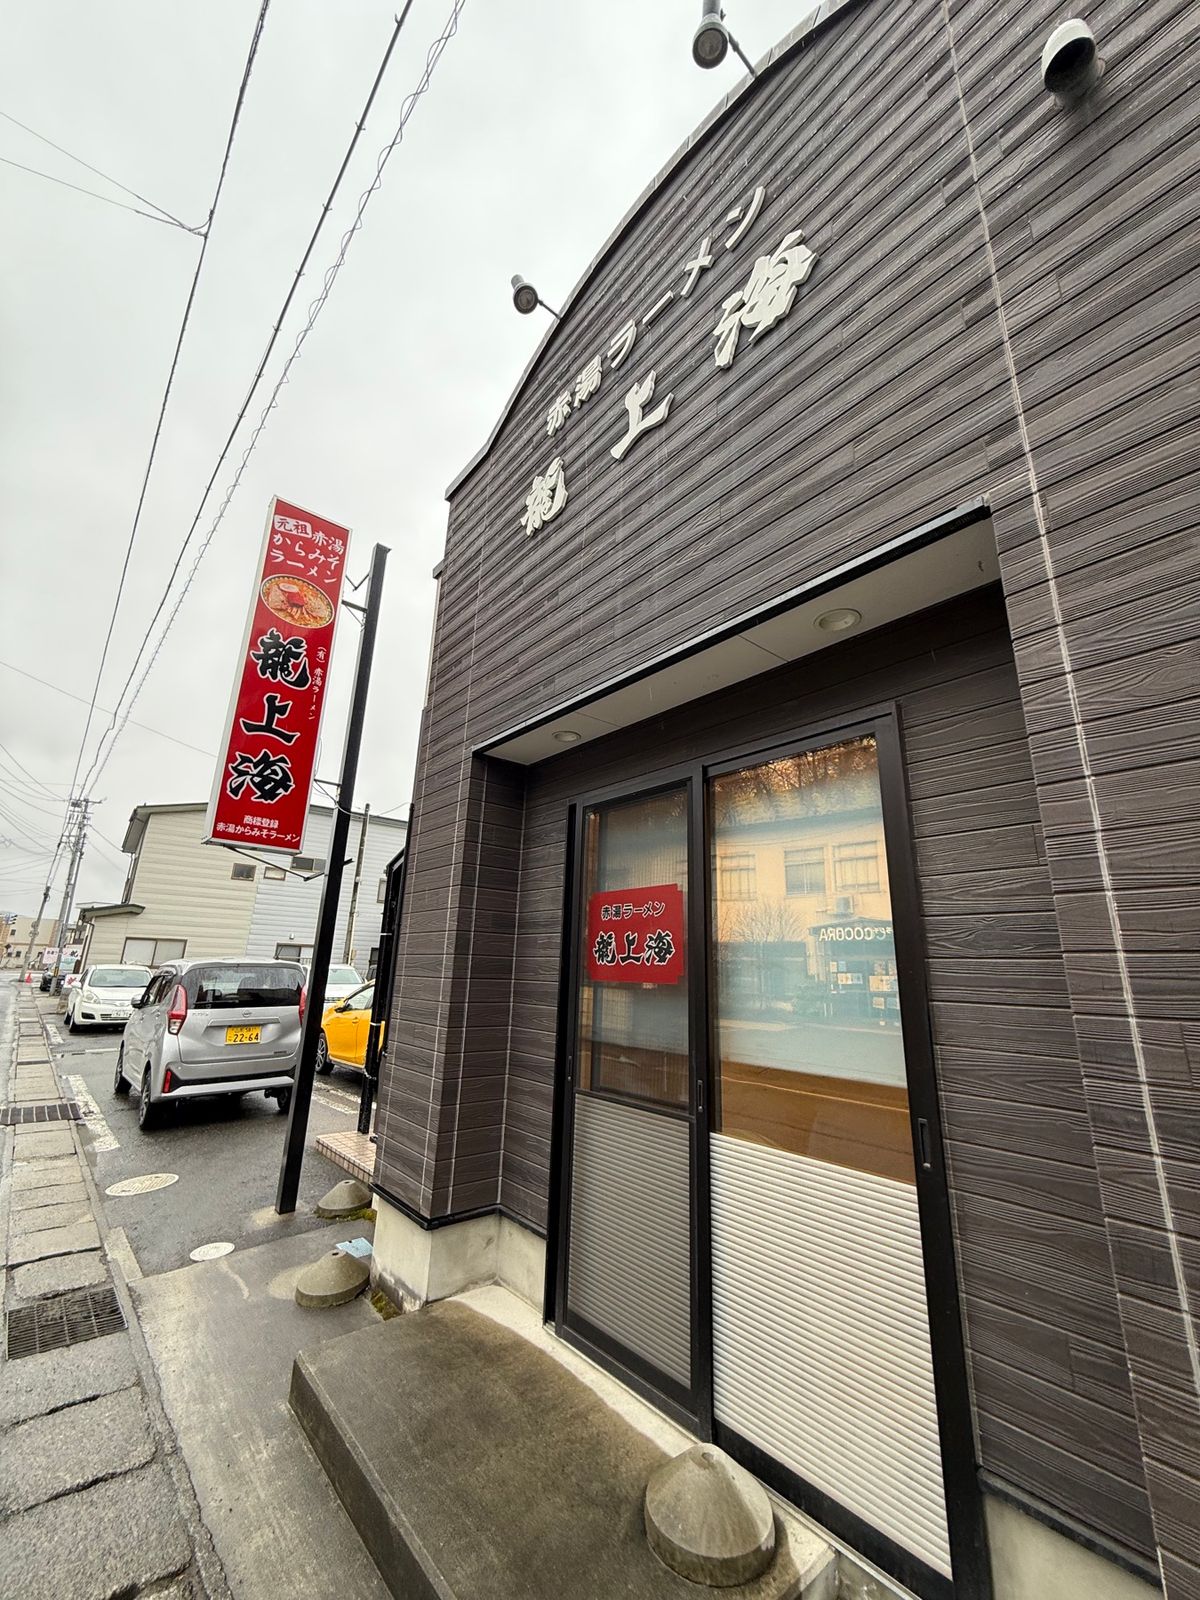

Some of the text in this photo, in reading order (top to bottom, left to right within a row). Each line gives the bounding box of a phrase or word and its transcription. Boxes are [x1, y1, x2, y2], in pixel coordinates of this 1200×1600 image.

[547, 186, 766, 437] 赤湯ラーメン
[519, 229, 819, 537] 龍上海
[270, 549, 338, 584] ラーメン
[272, 532, 340, 570] からみそ
[227, 627, 312, 804] 龍上海
[243, 815, 279, 829] 商標登録
[601, 901, 665, 920] 赤湯ラーメン
[593, 929, 675, 966] 龍上海
[233, 1033, 259, 1042] 22-64
